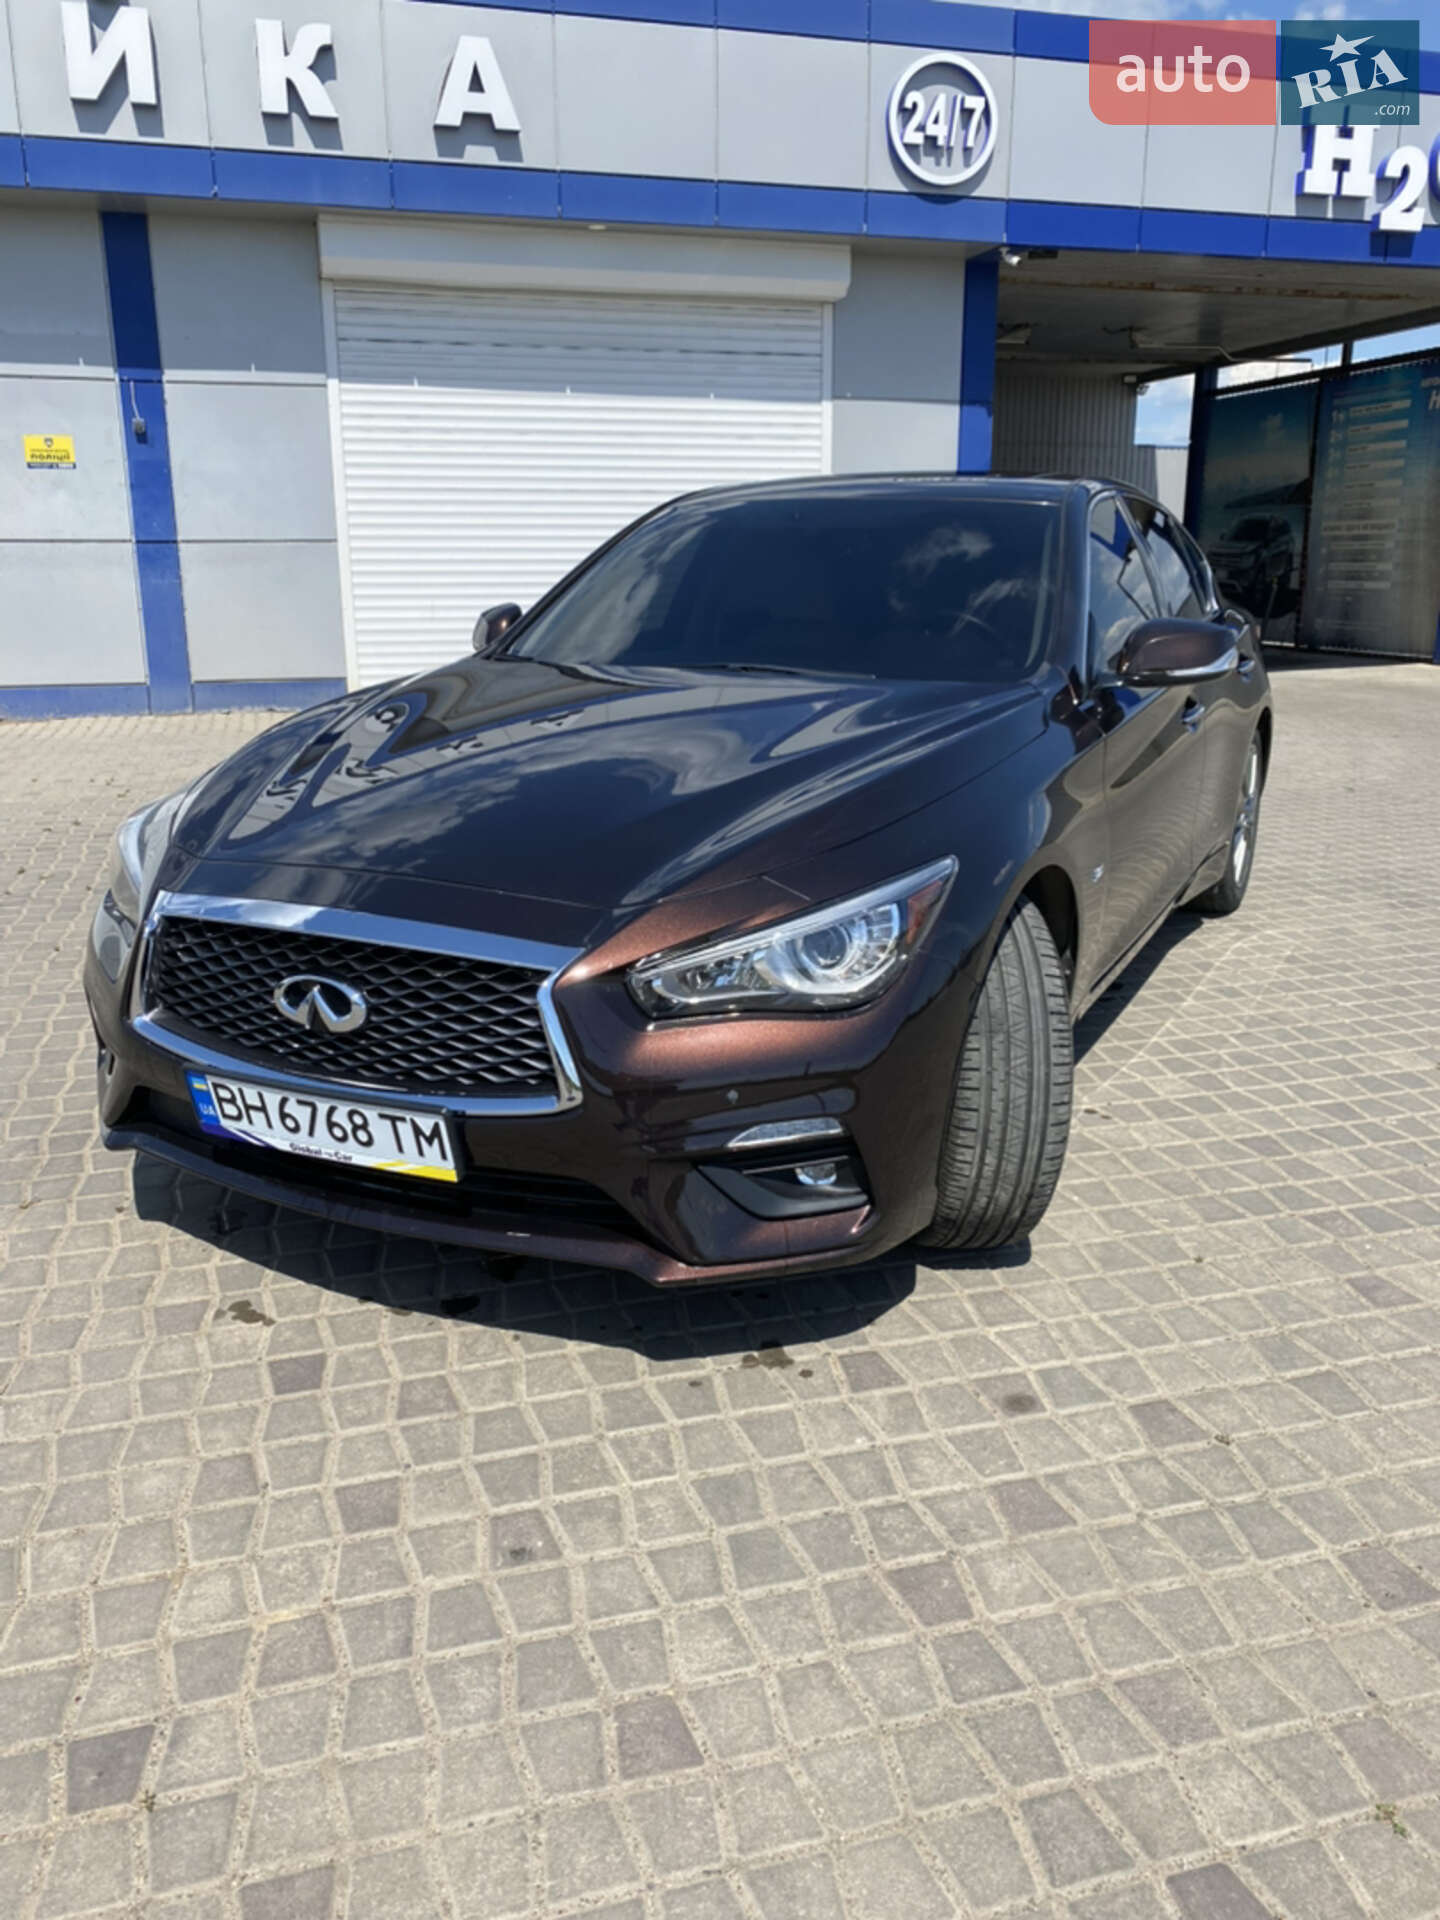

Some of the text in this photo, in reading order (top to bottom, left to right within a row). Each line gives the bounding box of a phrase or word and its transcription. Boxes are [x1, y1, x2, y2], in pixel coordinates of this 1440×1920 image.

[902, 89, 986, 148] 24/7
[1296, 124, 1440, 232] H2
[211, 1081, 449, 1161] BH 6768 TM
